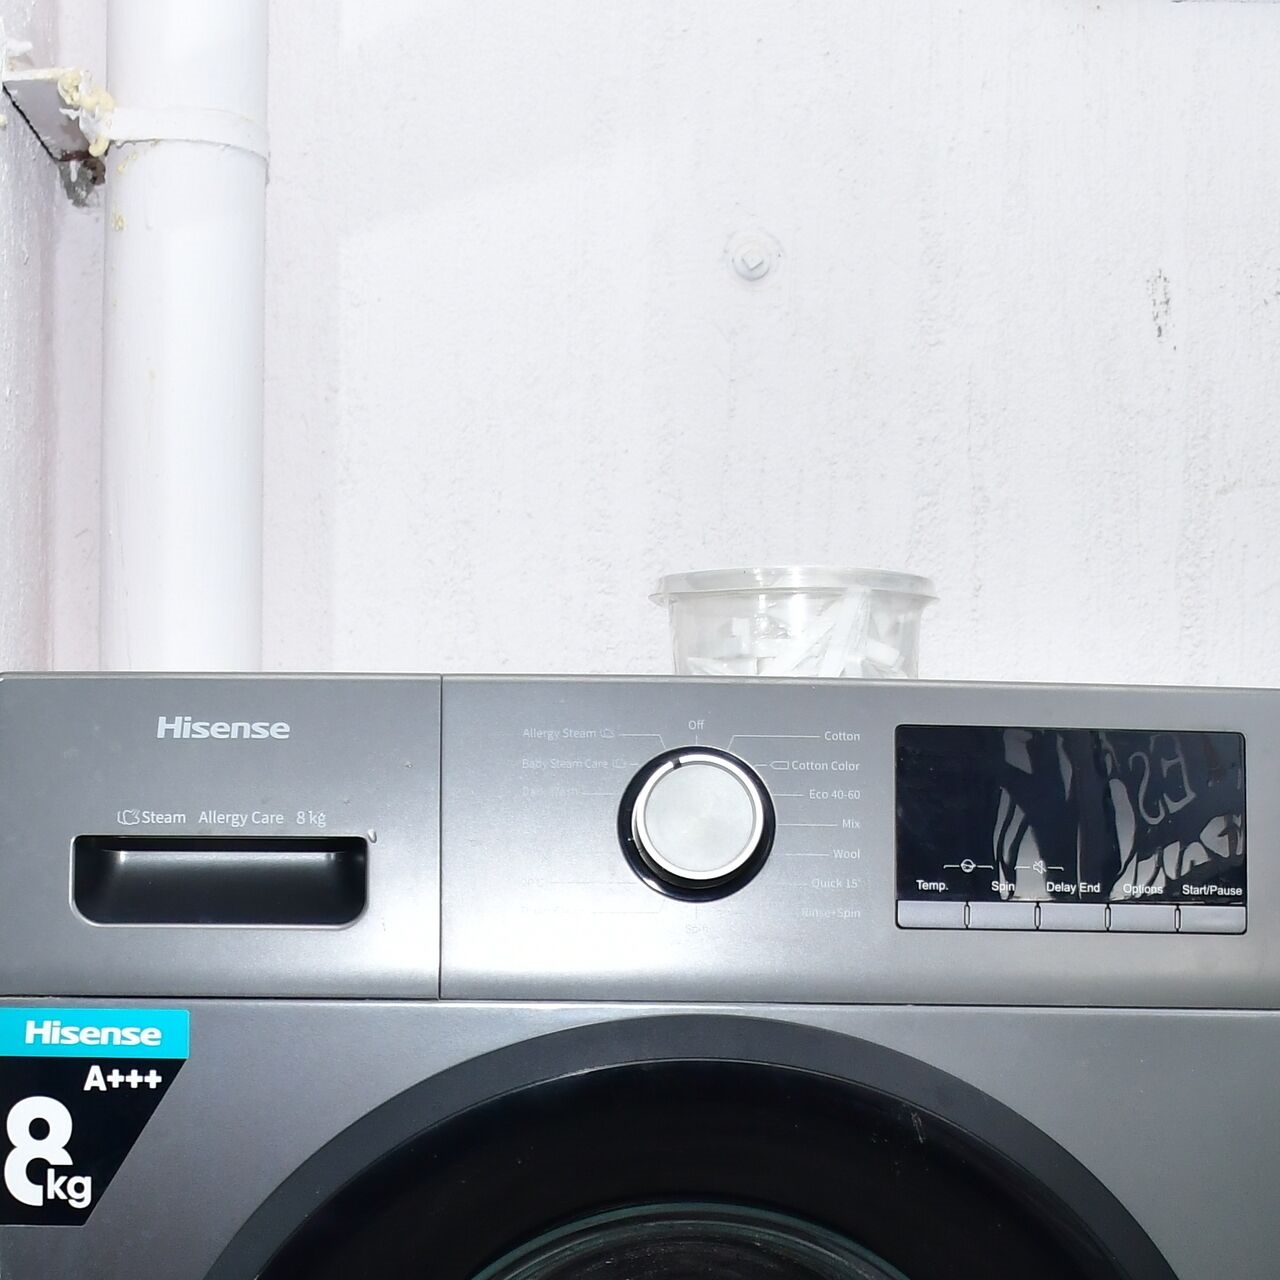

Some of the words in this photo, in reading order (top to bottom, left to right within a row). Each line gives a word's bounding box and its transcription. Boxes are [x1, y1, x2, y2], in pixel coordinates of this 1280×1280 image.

[156, 715, 291, 740] Hisense
[688, 718, 705, 730] Off
[562, 727, 597, 739] Steam
[824, 730, 861, 742] Cotton
[791, 760, 827, 772] Cotton
[830, 760, 861, 772] Color
[808, 789, 828, 800] Eco
[831, 789, 861, 800] 40-60
[142, 810, 186, 825] Steam
[198, 810, 247, 828] Allergy
[251, 810, 284, 825] Care
[296, 811, 305, 825] 8
[307, 810, 327, 828] kg
[842, 818, 861, 829] Mix
[833, 847, 861, 859] Wool
[811, 877, 842, 889] Quick
[916, 879, 949, 892] Temp.
[991, 881, 1015, 894] Spin
[1046, 881, 1077, 895] Delay
[1079, 882, 1101, 894] End
[1122, 883, 1164, 896] Options
[1182, 884, 1243, 896] Start/Pause
[24, 1020, 162, 1046] Hisense
[83, 1065, 162, 1091] A+++
